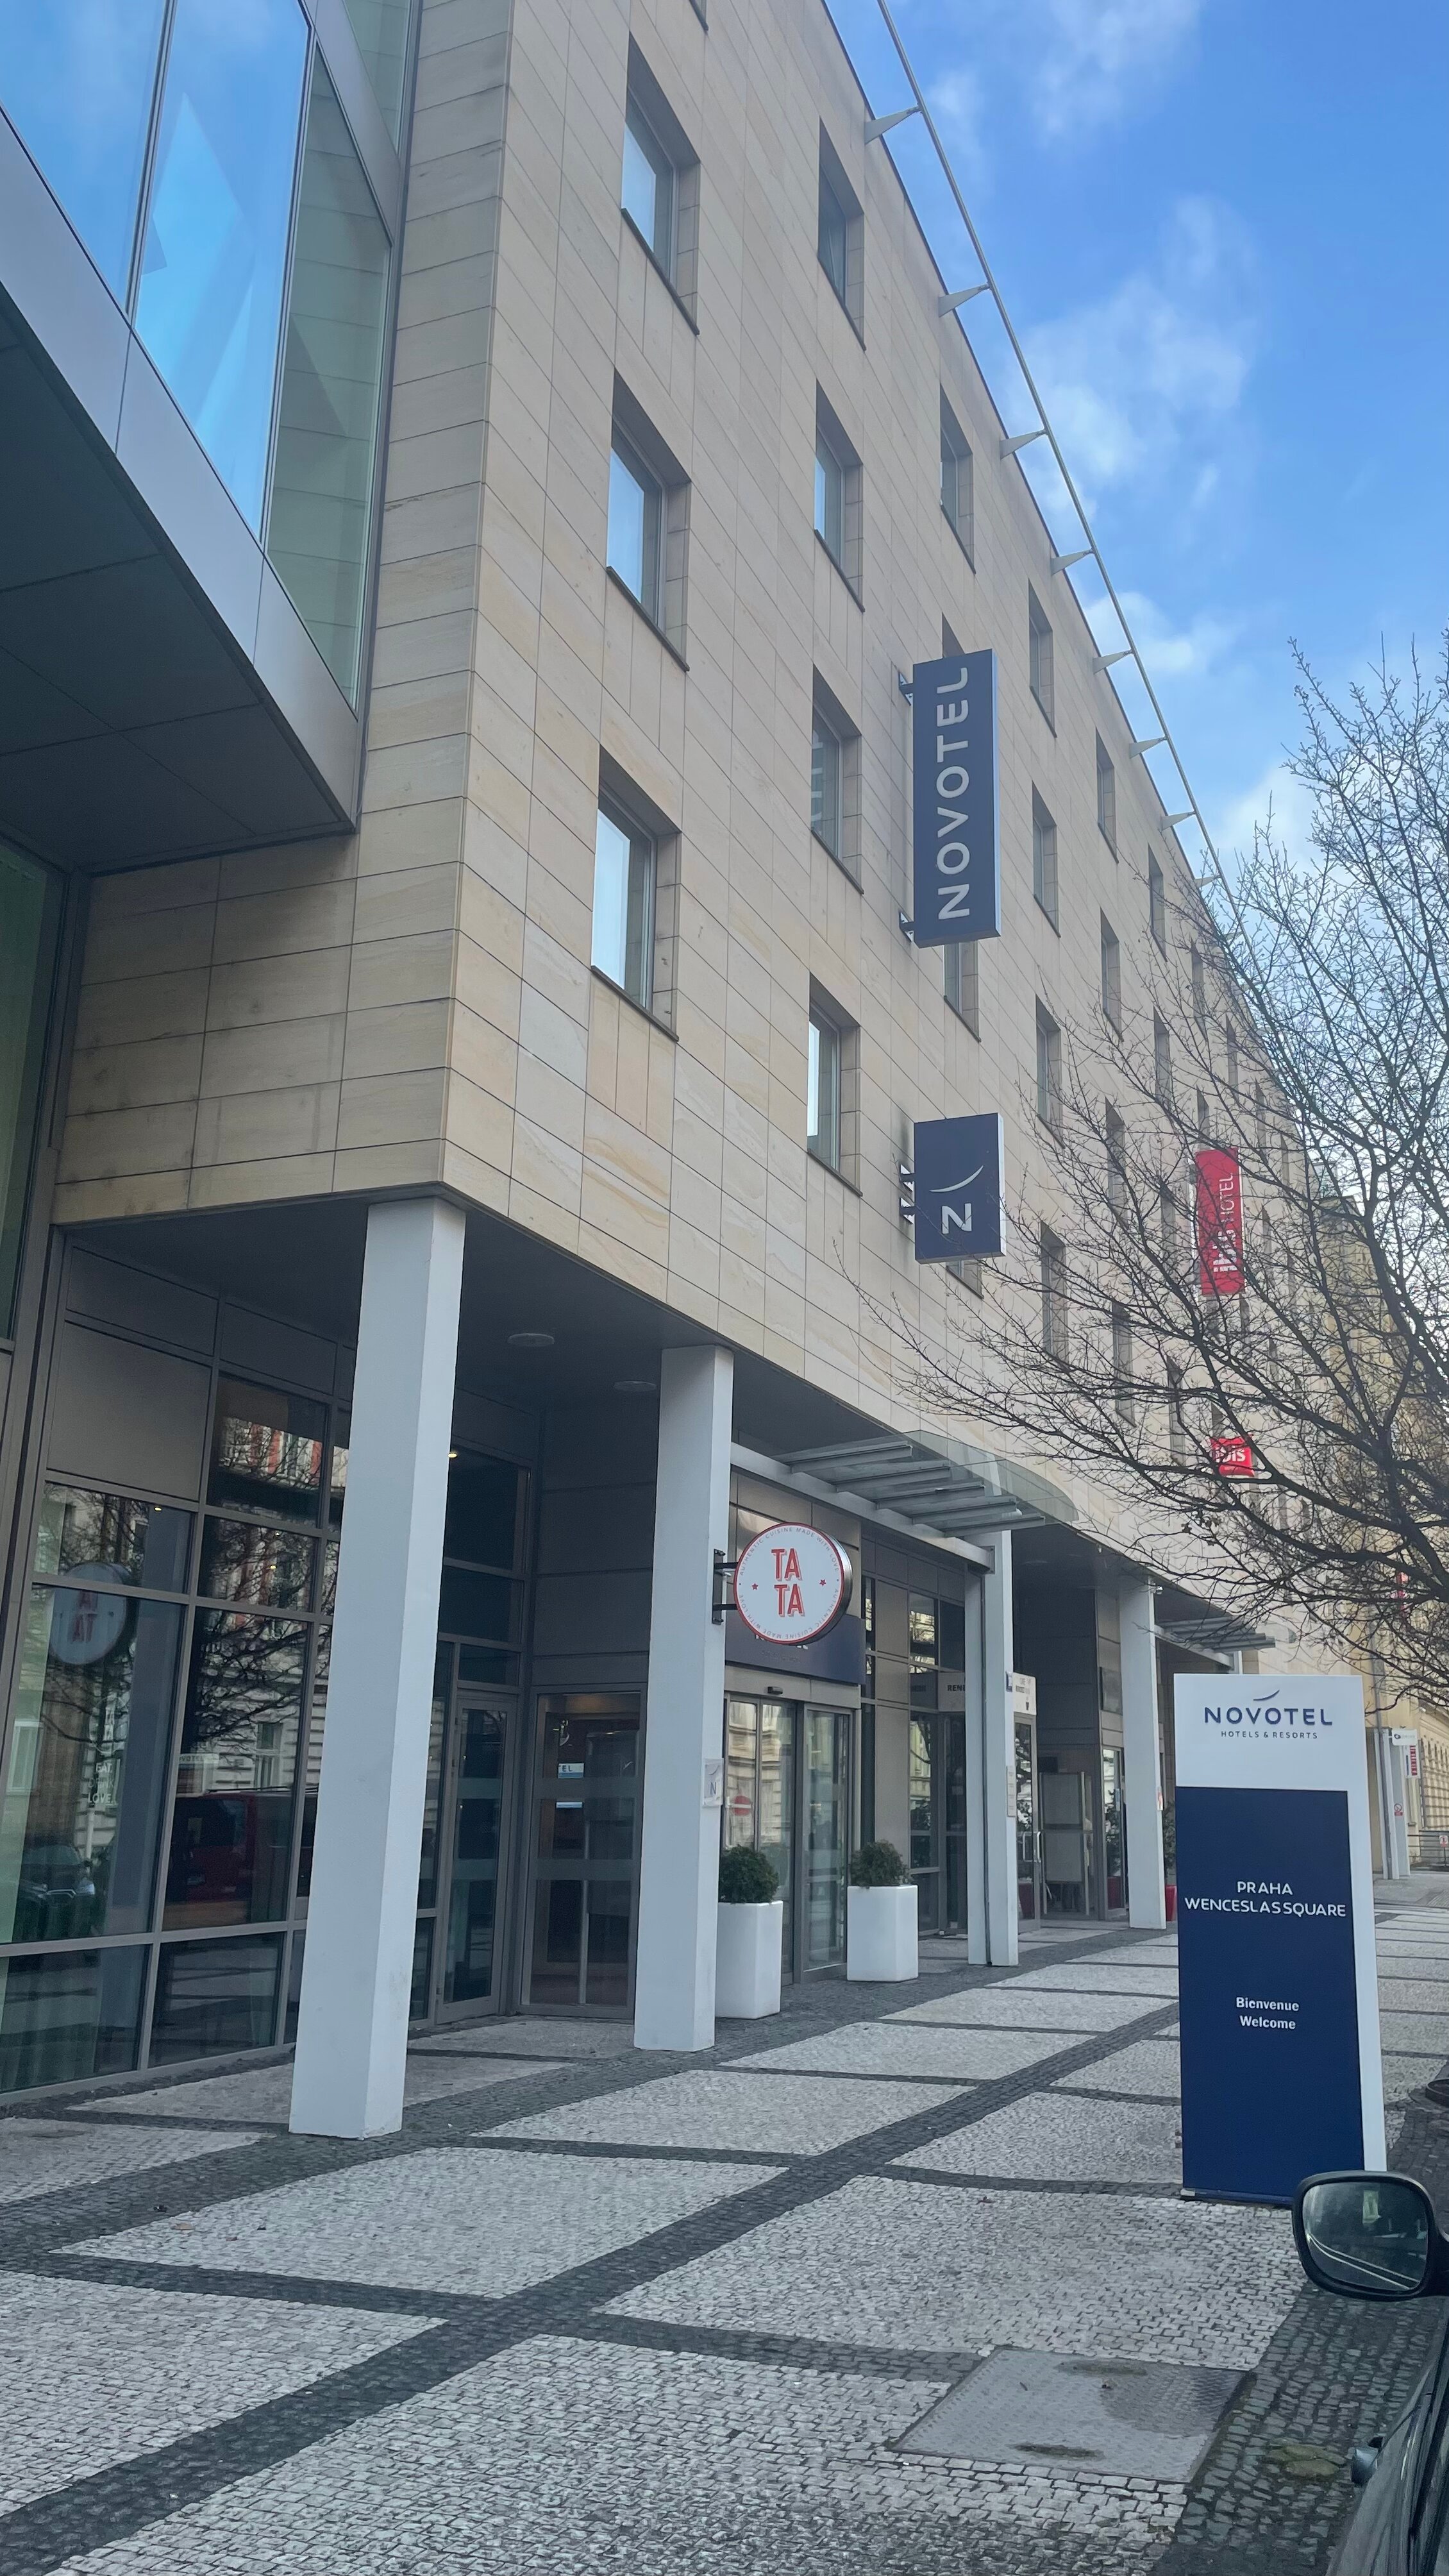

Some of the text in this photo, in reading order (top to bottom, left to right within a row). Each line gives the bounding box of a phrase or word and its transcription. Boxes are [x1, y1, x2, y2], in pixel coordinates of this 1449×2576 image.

[936, 667, 970, 920] NOVOTEL
[941, 1202, 972, 1234] N
[739, 1527, 839, 1576] AUTHENTIC CUISINE MADE WITH LOVE
[771, 1547, 802, 1581] TA
[739, 1588, 839, 1639] AUTHENTIC CUISINE MADE WITH LOVE
[774, 1583, 805, 1617] TA
[1204, 1706, 1333, 1726] NOVOTEL
[1273, 1731, 1318, 1740] RESORTS
[1237, 1881, 1293, 1896] PRAHA
[1235, 1996, 1300, 2012] Bienvenue
[1239, 2015, 1296, 2030] Welcome
